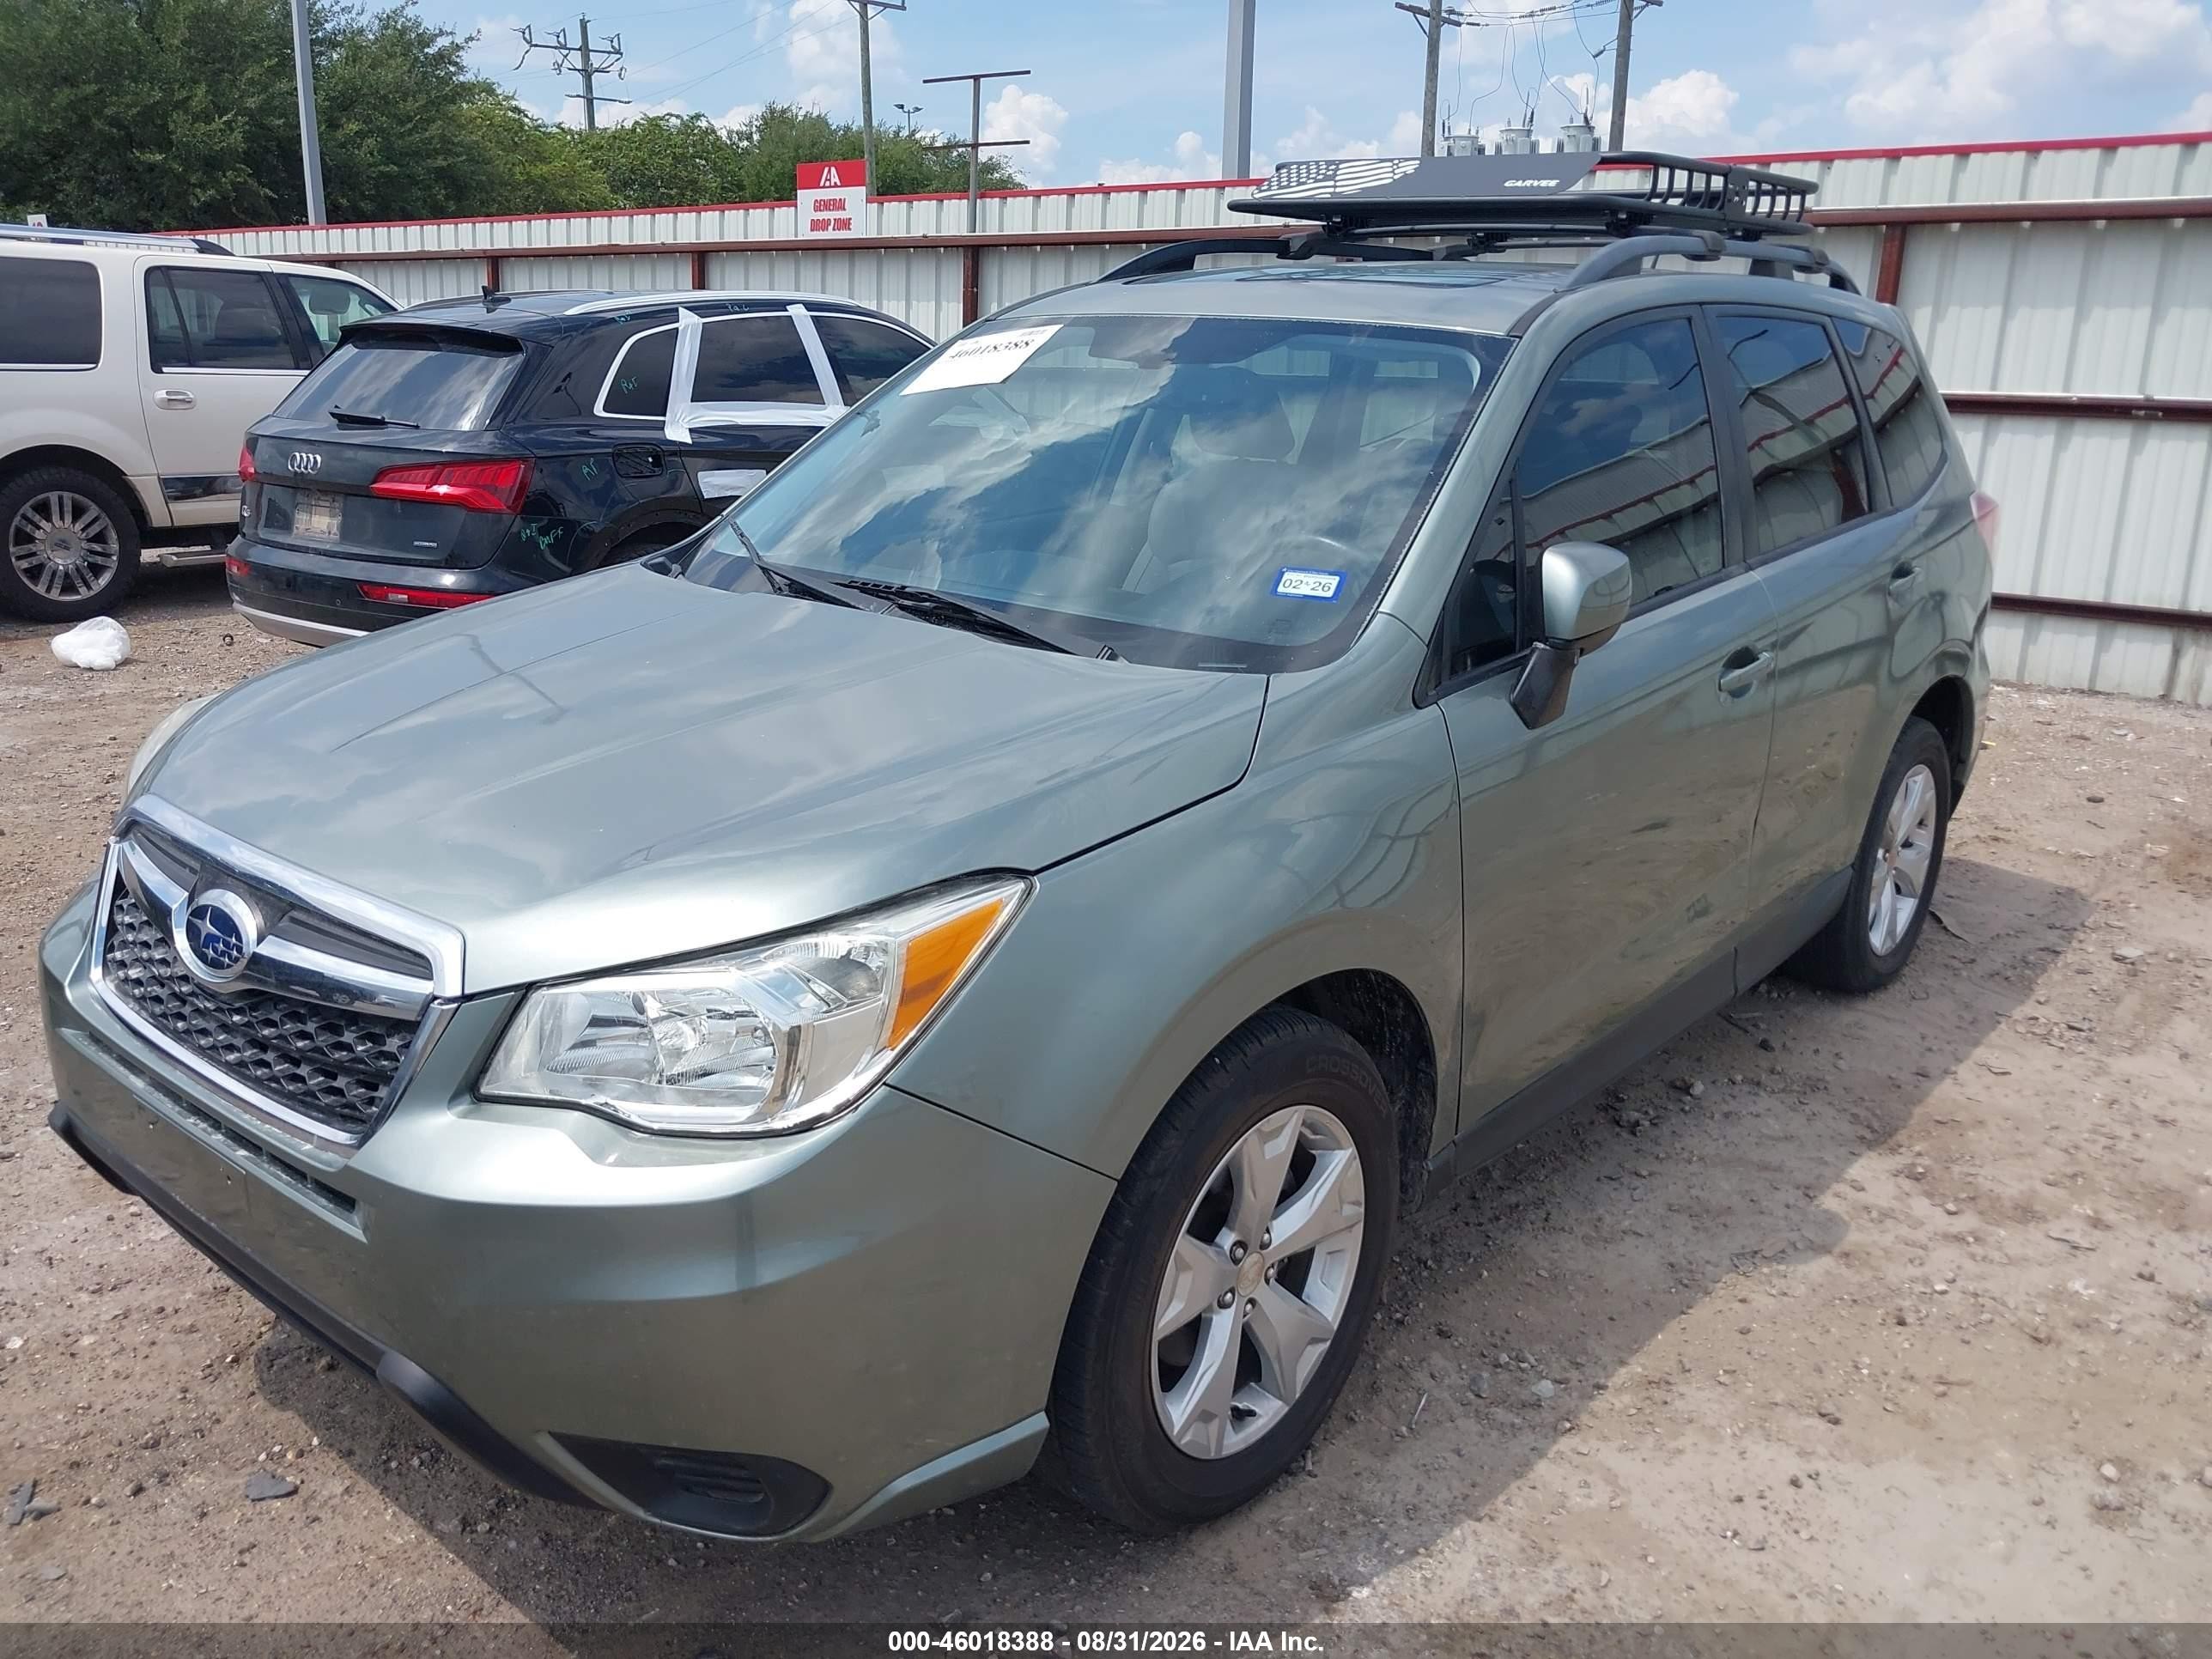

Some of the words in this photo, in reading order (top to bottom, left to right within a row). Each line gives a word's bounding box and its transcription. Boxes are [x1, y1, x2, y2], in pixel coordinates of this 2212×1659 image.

[813, 198, 847, 213] GENERAL
[810, 218, 831, 232] DROP
[832, 217, 852, 231] ZONE
[1283, 578, 1304, 589] 02
[1310, 580, 1333, 592] 26
